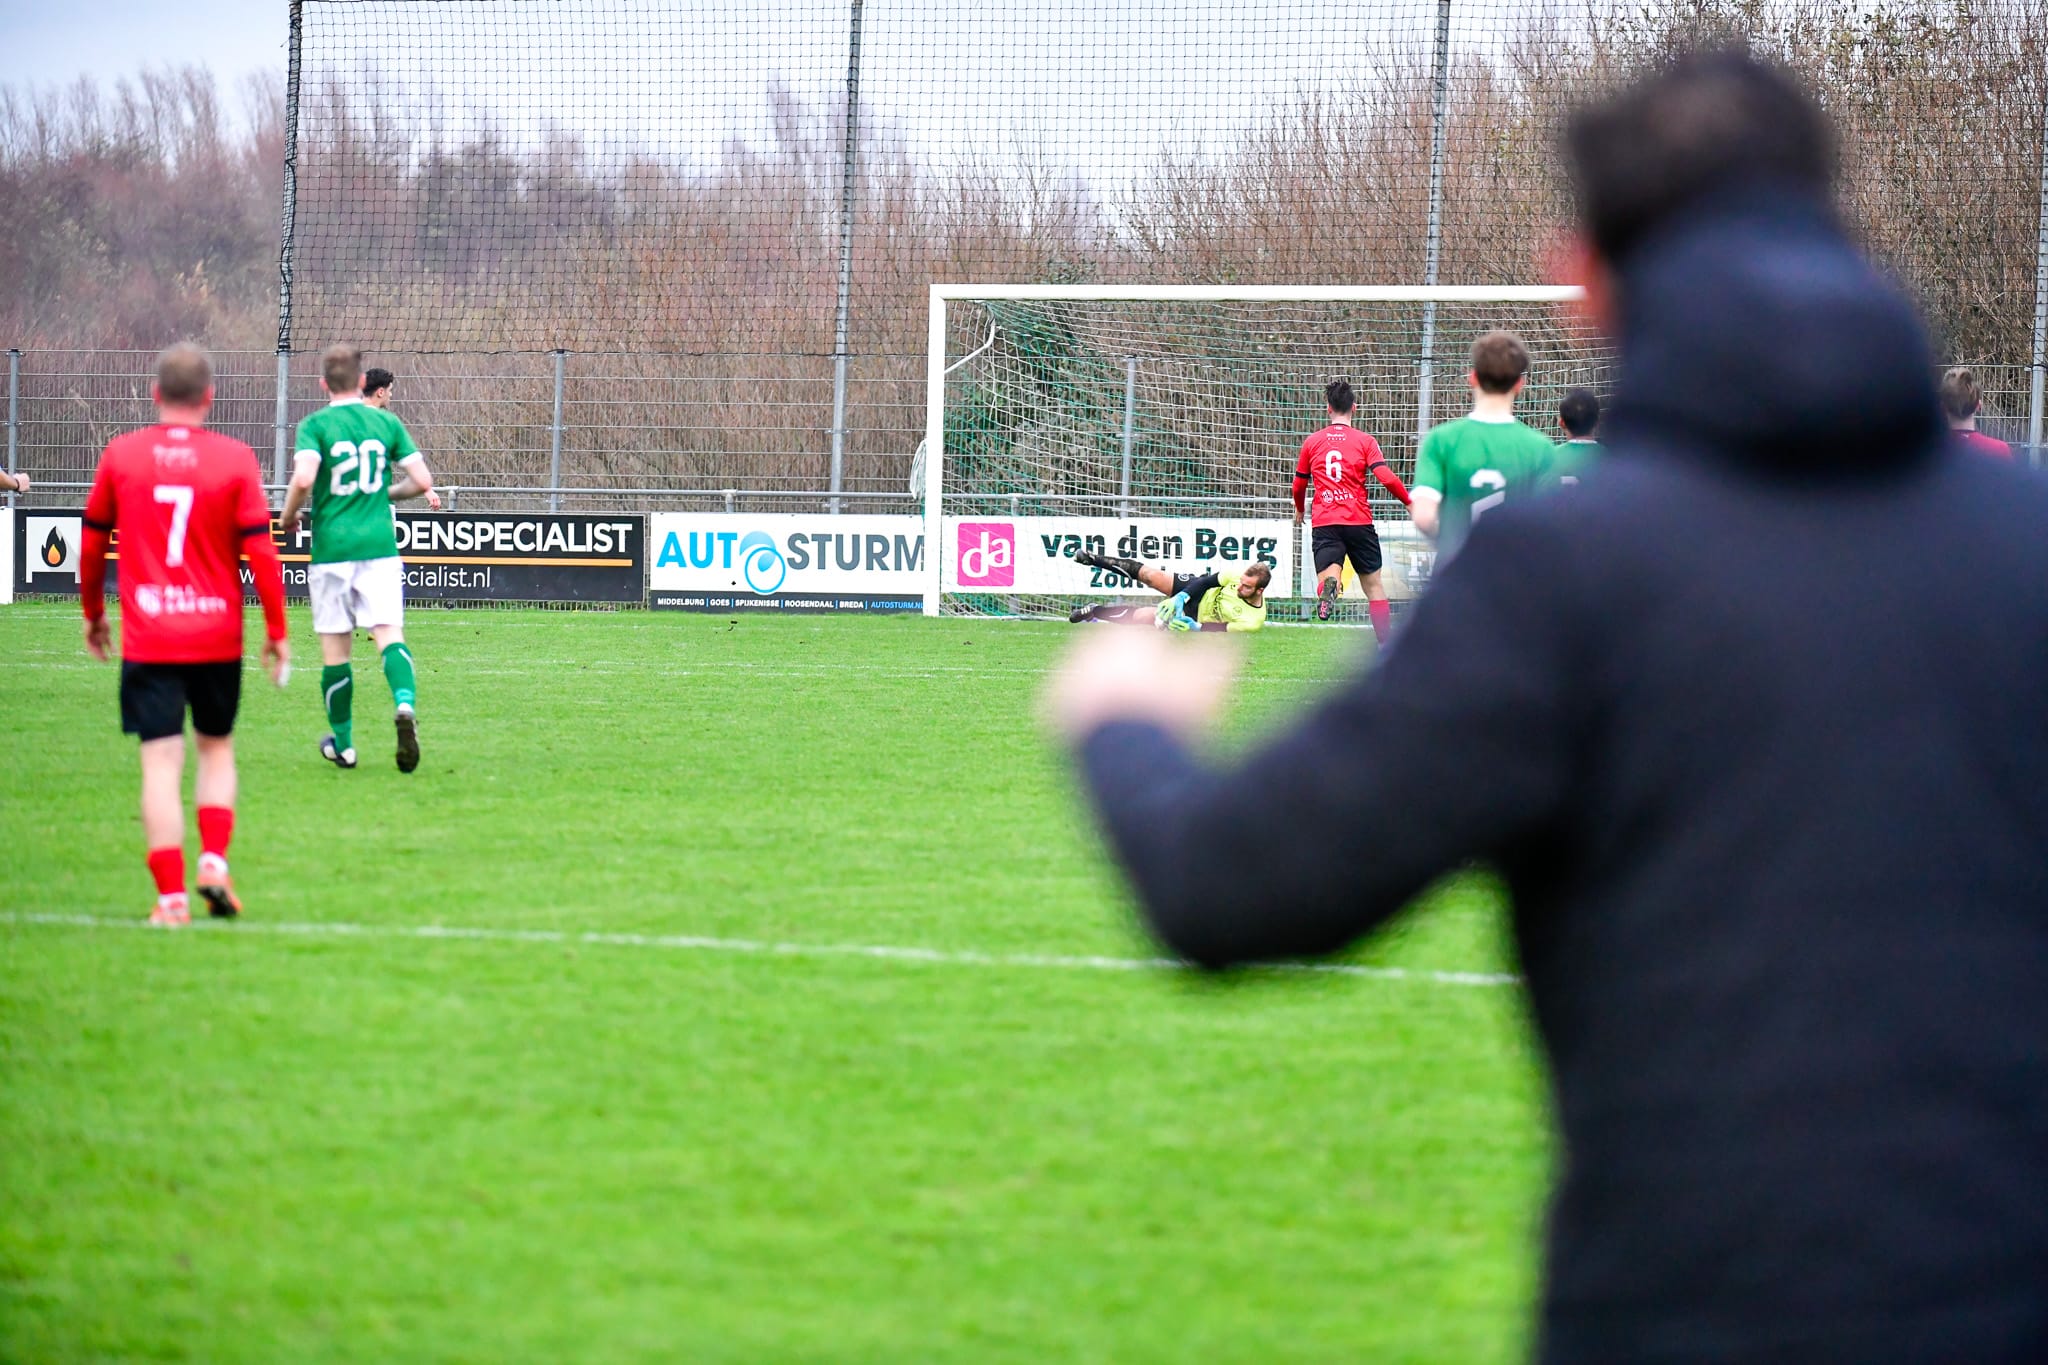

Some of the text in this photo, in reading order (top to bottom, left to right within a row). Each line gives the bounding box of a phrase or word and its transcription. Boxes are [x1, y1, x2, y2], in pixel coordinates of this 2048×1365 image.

[330, 439, 386, 497] 20
[1325, 450, 1342, 483] 6
[153, 485, 194, 568] 7
[1040, 525, 1277, 571] van den Berg
[961, 531, 1011, 578] da
[657, 597, 705, 606] MIDDELBURG
[709, 598, 731, 607] GOES
[735, 599, 780, 608] SPIJKENISSE
[784, 599, 834, 608] ROOSENDAAL
[839, 600, 864, 609] BREDA
